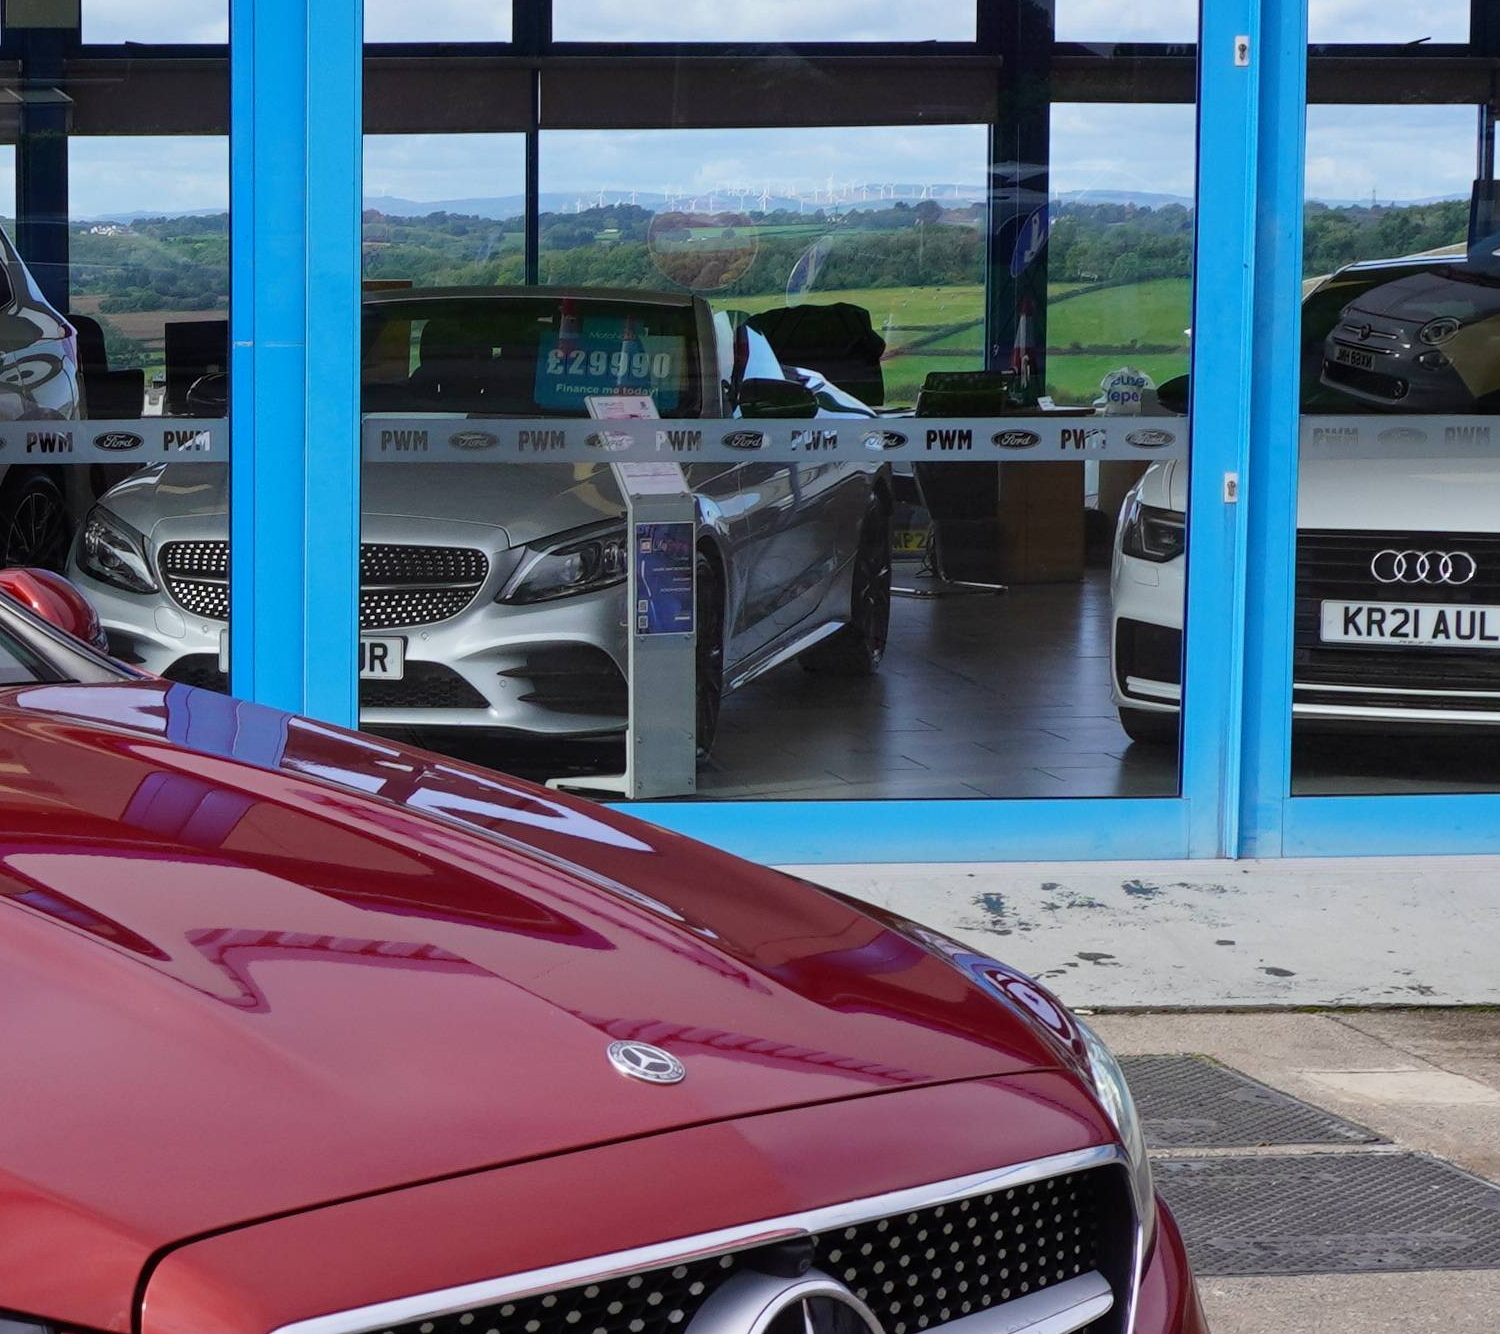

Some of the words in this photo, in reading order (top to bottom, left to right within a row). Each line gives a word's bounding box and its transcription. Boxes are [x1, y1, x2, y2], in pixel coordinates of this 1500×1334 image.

[547, 348, 672, 379] £29990
[556, 383, 599, 394] Finance
[602, 386, 620, 395] me
[26, 432, 73, 453] PWM
[163, 430, 211, 451] PWM
[380, 430, 428, 451] PWM
[518, 430, 566, 451] PWM
[655, 430, 703, 451] PWM
[791, 429, 838, 450] PWM
[926, 429, 973, 450] PWM
[1445, 426, 1491, 447] PWM
[1343, 606, 1420, 638] KR21
[1431, 610, 1499, 641] AUL
